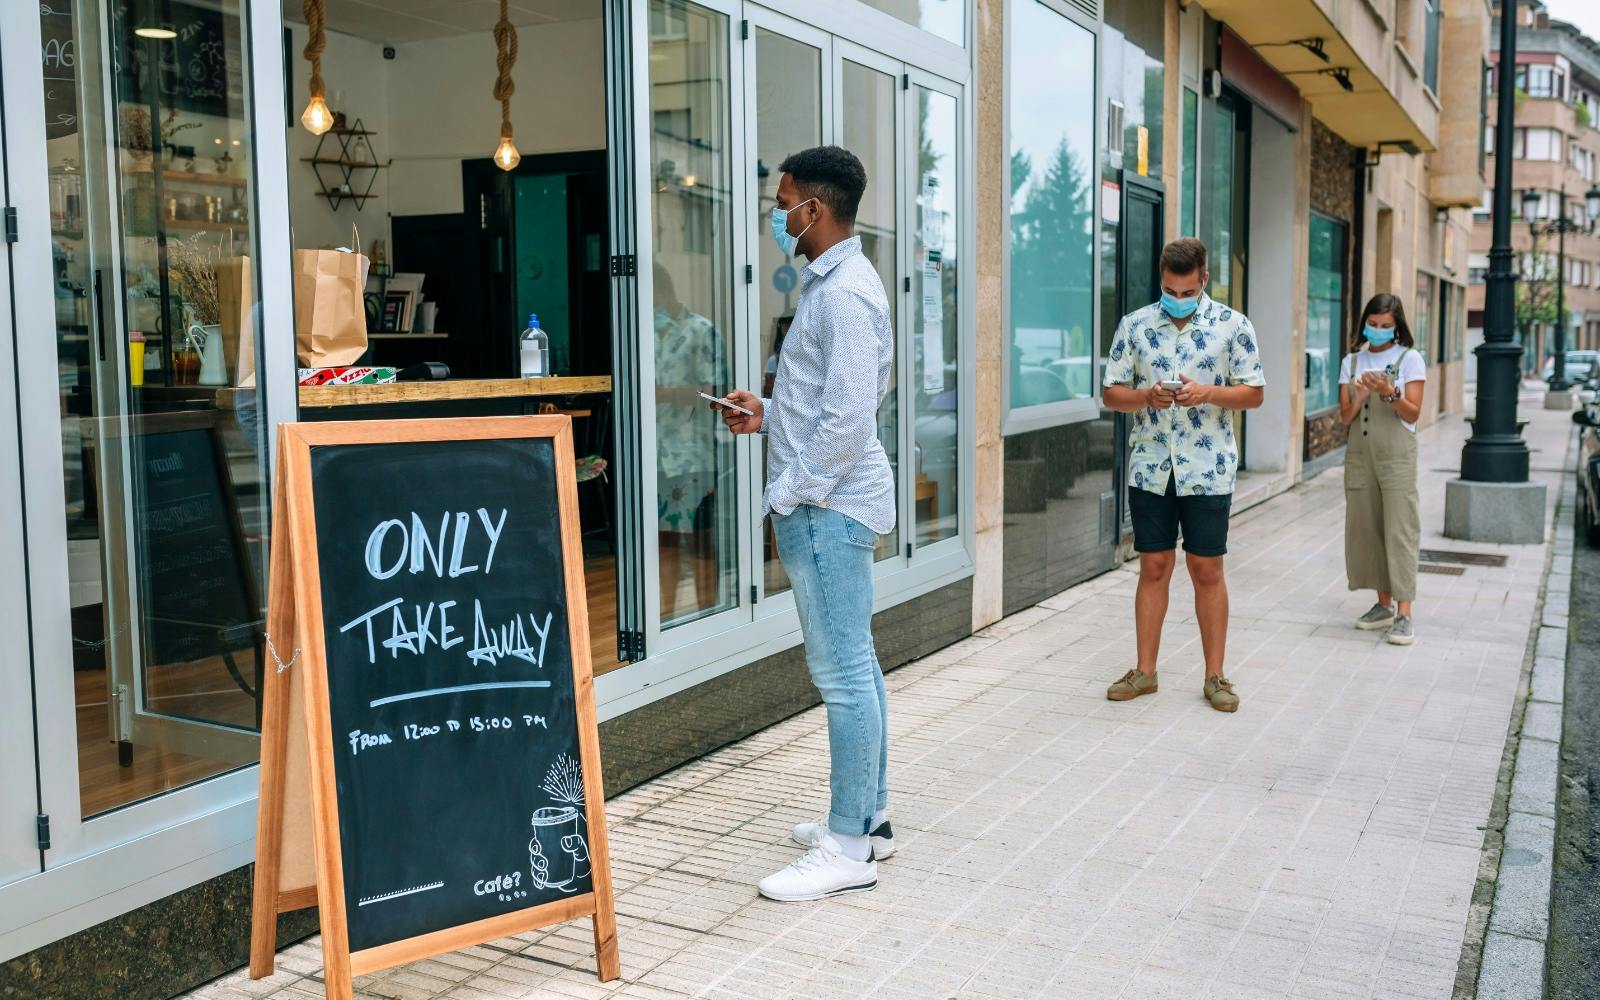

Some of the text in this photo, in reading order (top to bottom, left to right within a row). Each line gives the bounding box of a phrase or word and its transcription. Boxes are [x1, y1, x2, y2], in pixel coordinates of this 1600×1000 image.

[365, 508, 507, 580] ONLY
[339, 598, 553, 668] TAKE AWAY
[404, 724, 440, 740] 12:00
[470, 716, 512, 732] 15:00
[523, 714, 547, 729] PM
